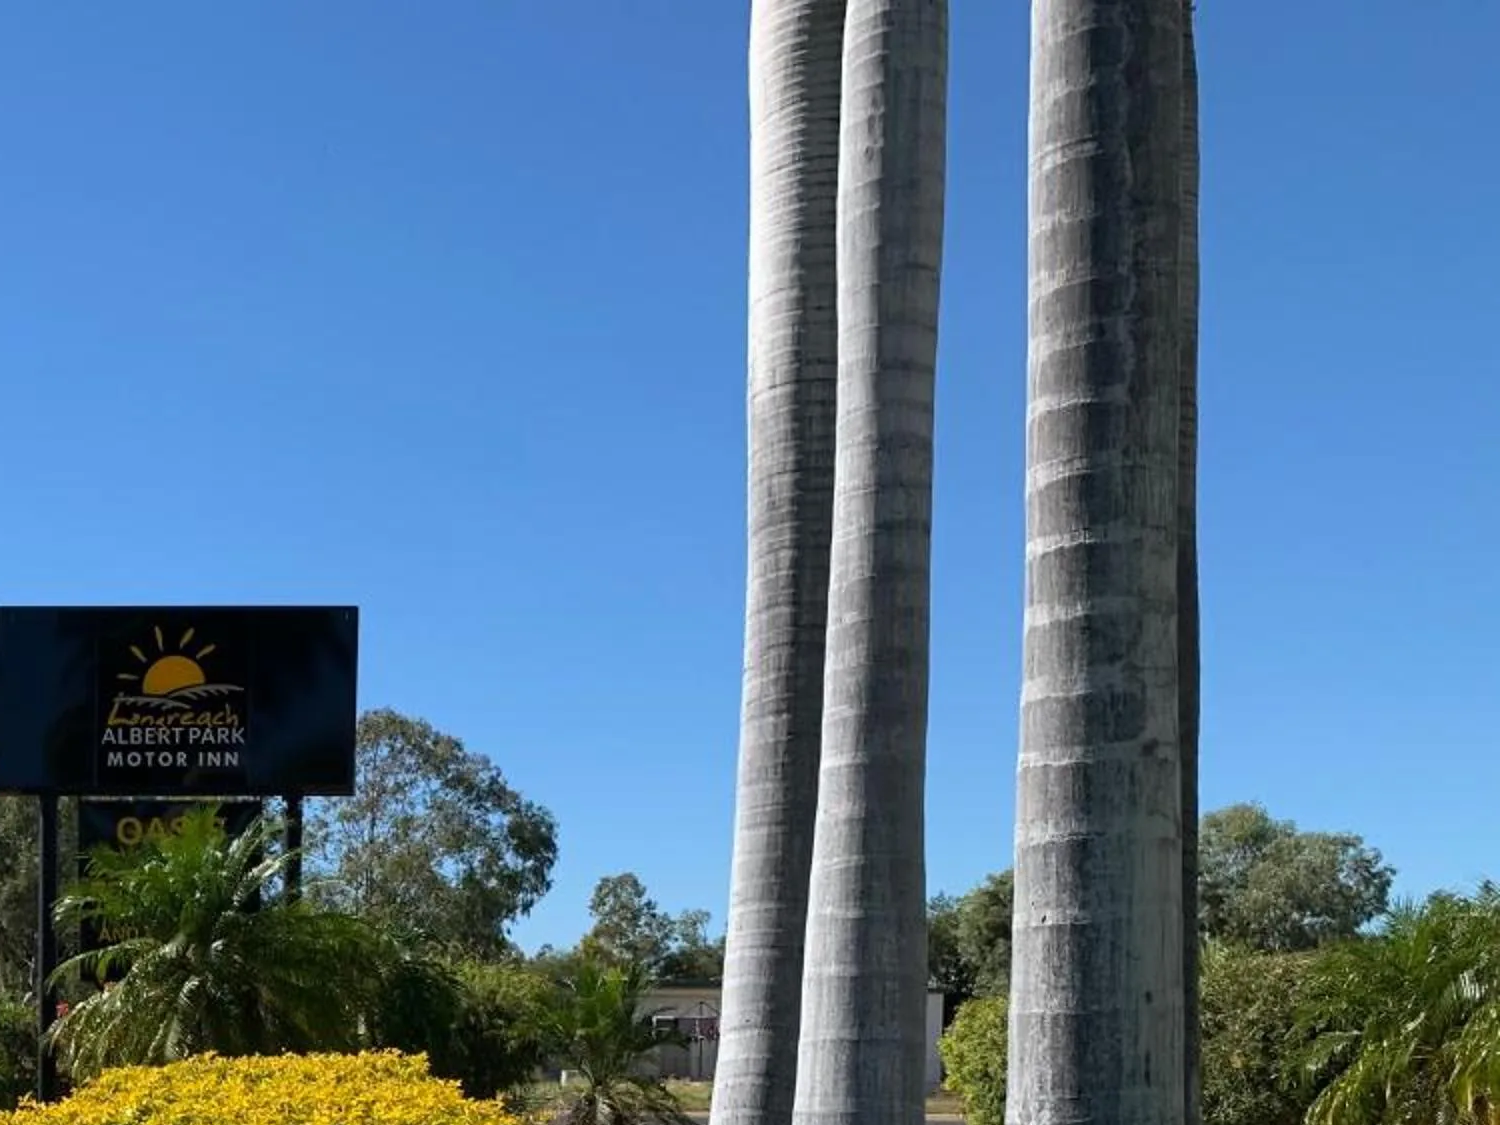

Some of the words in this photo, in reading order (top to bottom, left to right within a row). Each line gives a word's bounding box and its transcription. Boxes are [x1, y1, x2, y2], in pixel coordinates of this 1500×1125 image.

[101, 727, 182, 745] ALBERT
[188, 727, 245, 745] PARK
[107, 751, 188, 768] MOTOR
[197, 751, 239, 768] INN
